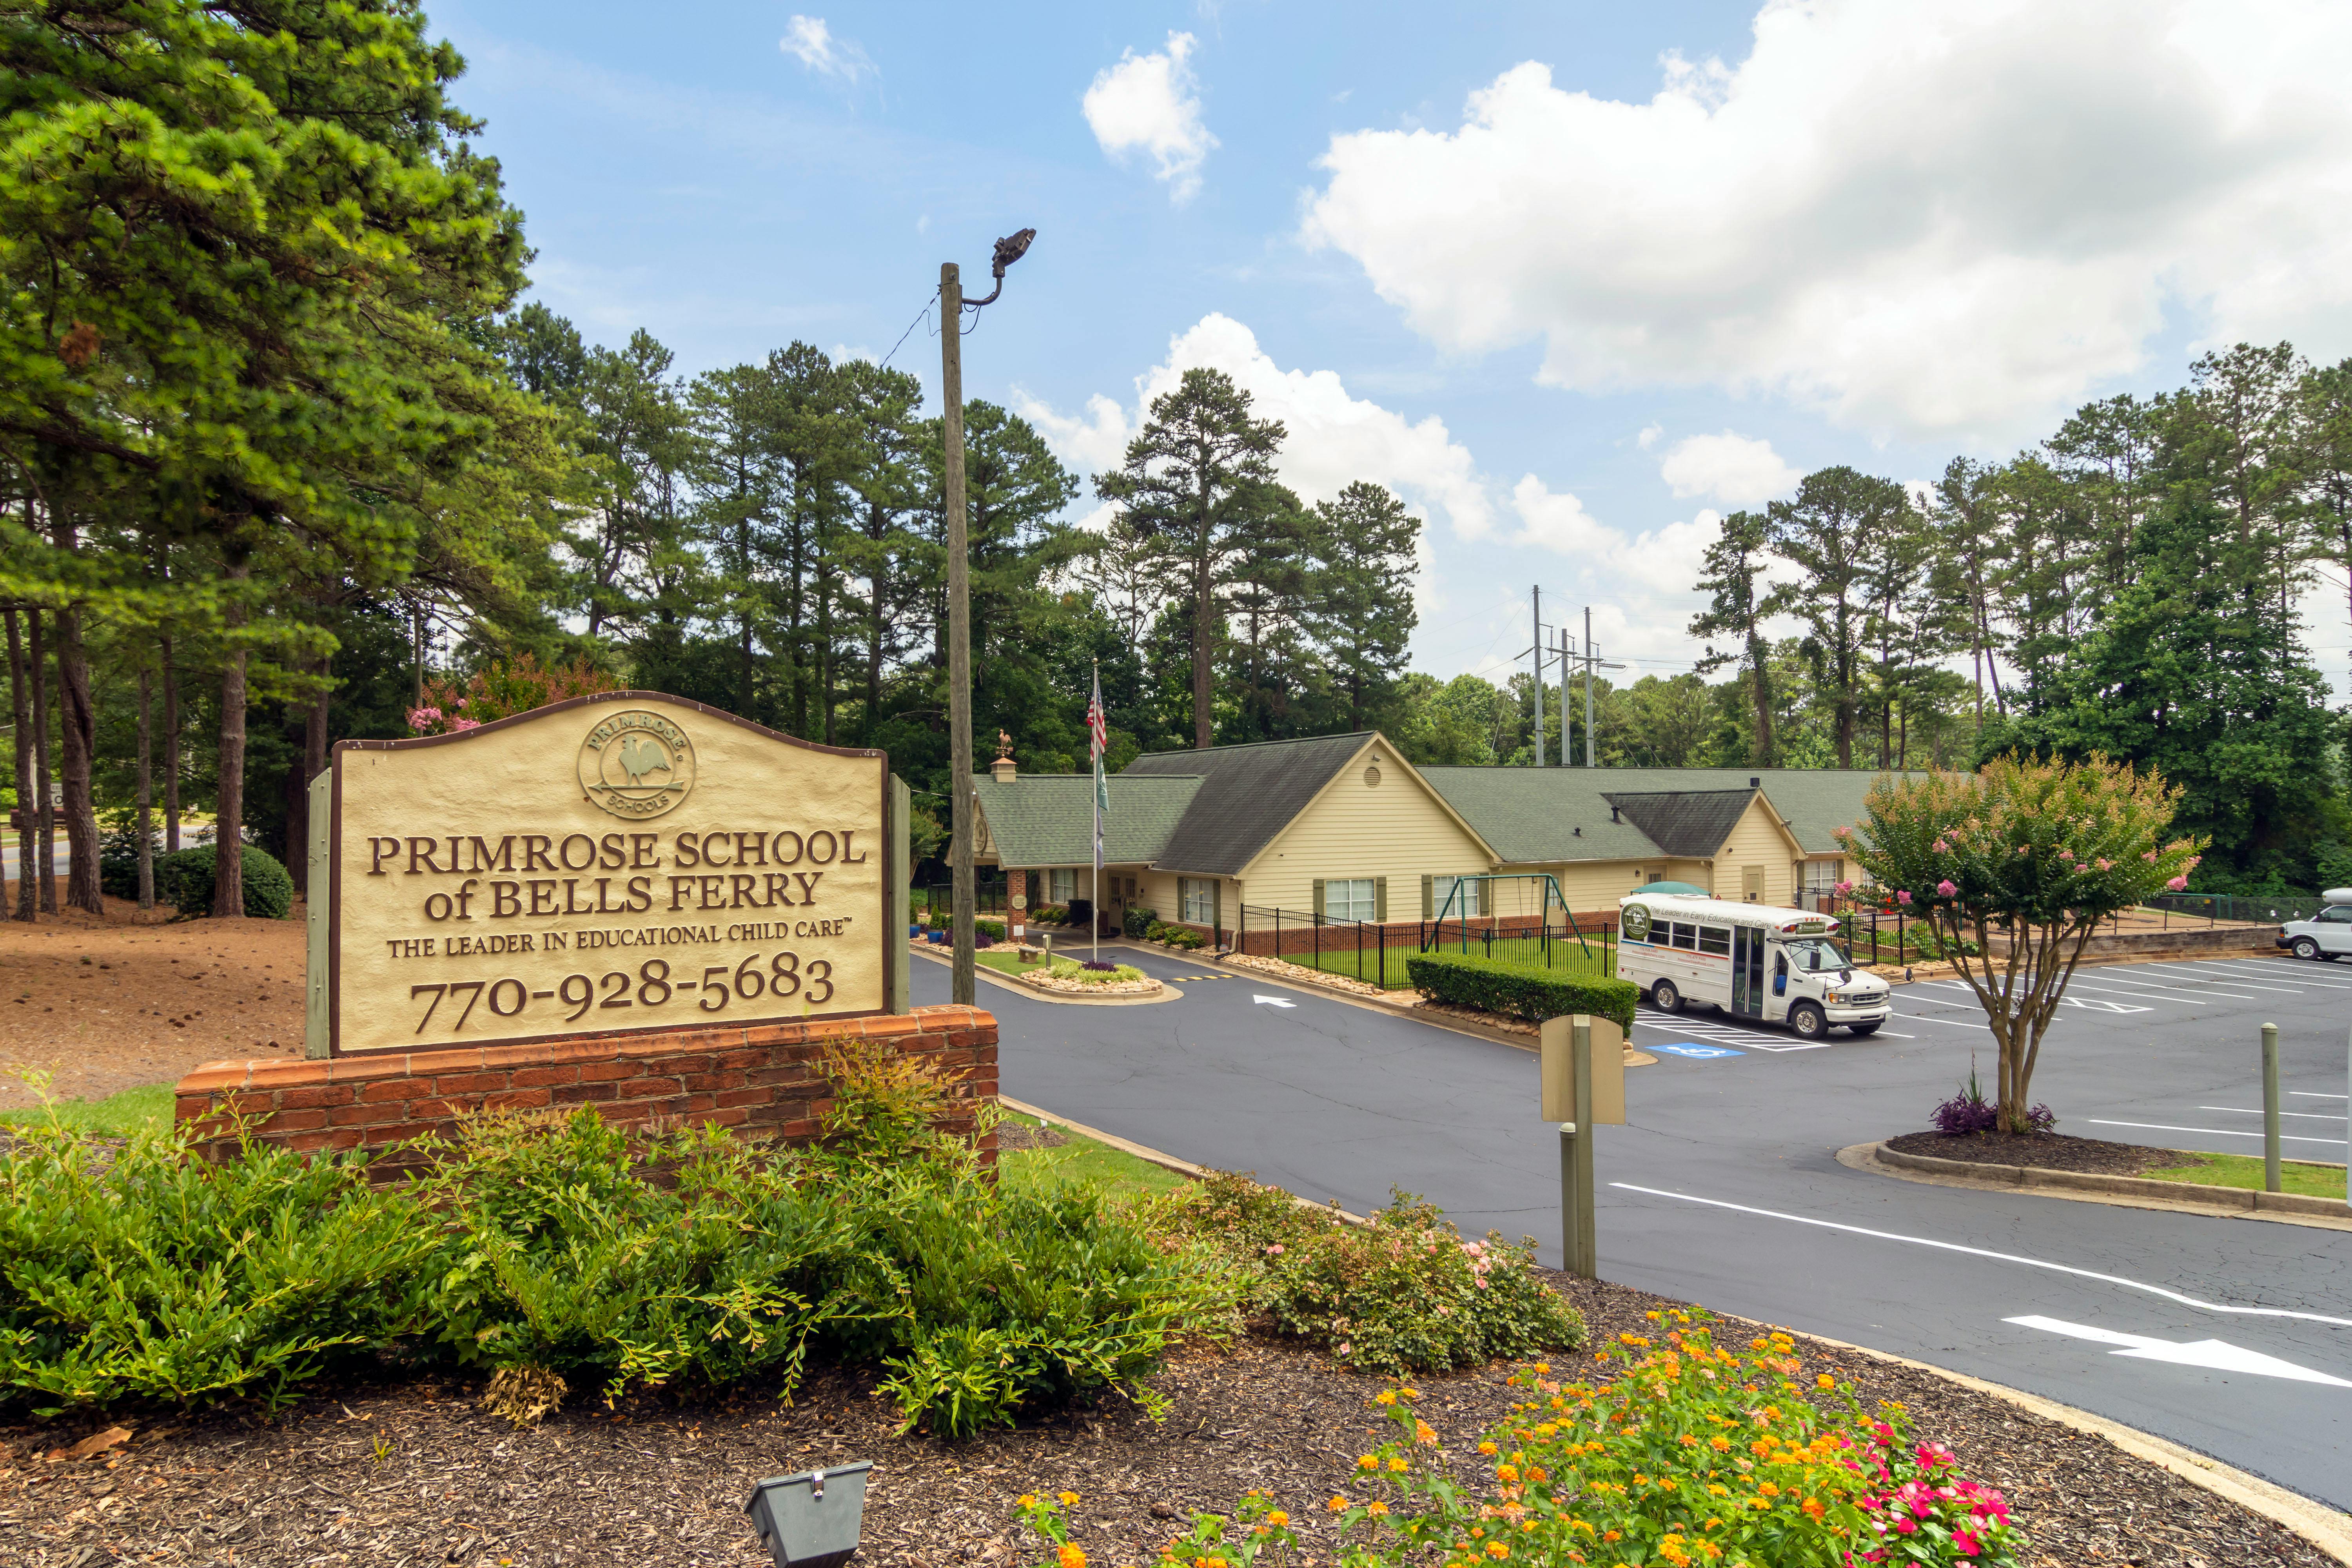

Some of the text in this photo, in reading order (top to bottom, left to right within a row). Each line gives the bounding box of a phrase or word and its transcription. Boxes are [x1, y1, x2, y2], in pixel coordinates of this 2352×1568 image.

[608, 795, 669, 812] SCHOOLS
[367, 830, 866, 875] PRIMROSE SCHOOL
[425, 872, 824, 921] of BELLS FERRY
[1650, 906, 1661, 914] The
[1661, 907, 1683, 917] Leader
[1690, 911, 1706, 922] Early
[1708, 913, 1739, 924] Education
[387, 938, 436, 958] THE
[445, 934, 535, 956] LEADER
[543, 931, 568, 950] IN
[576, 925, 721, 949] EDUCATIONAL
[728, 921, 789, 941] CHILD
[411, 951, 834, 1034] 770-928-5683
